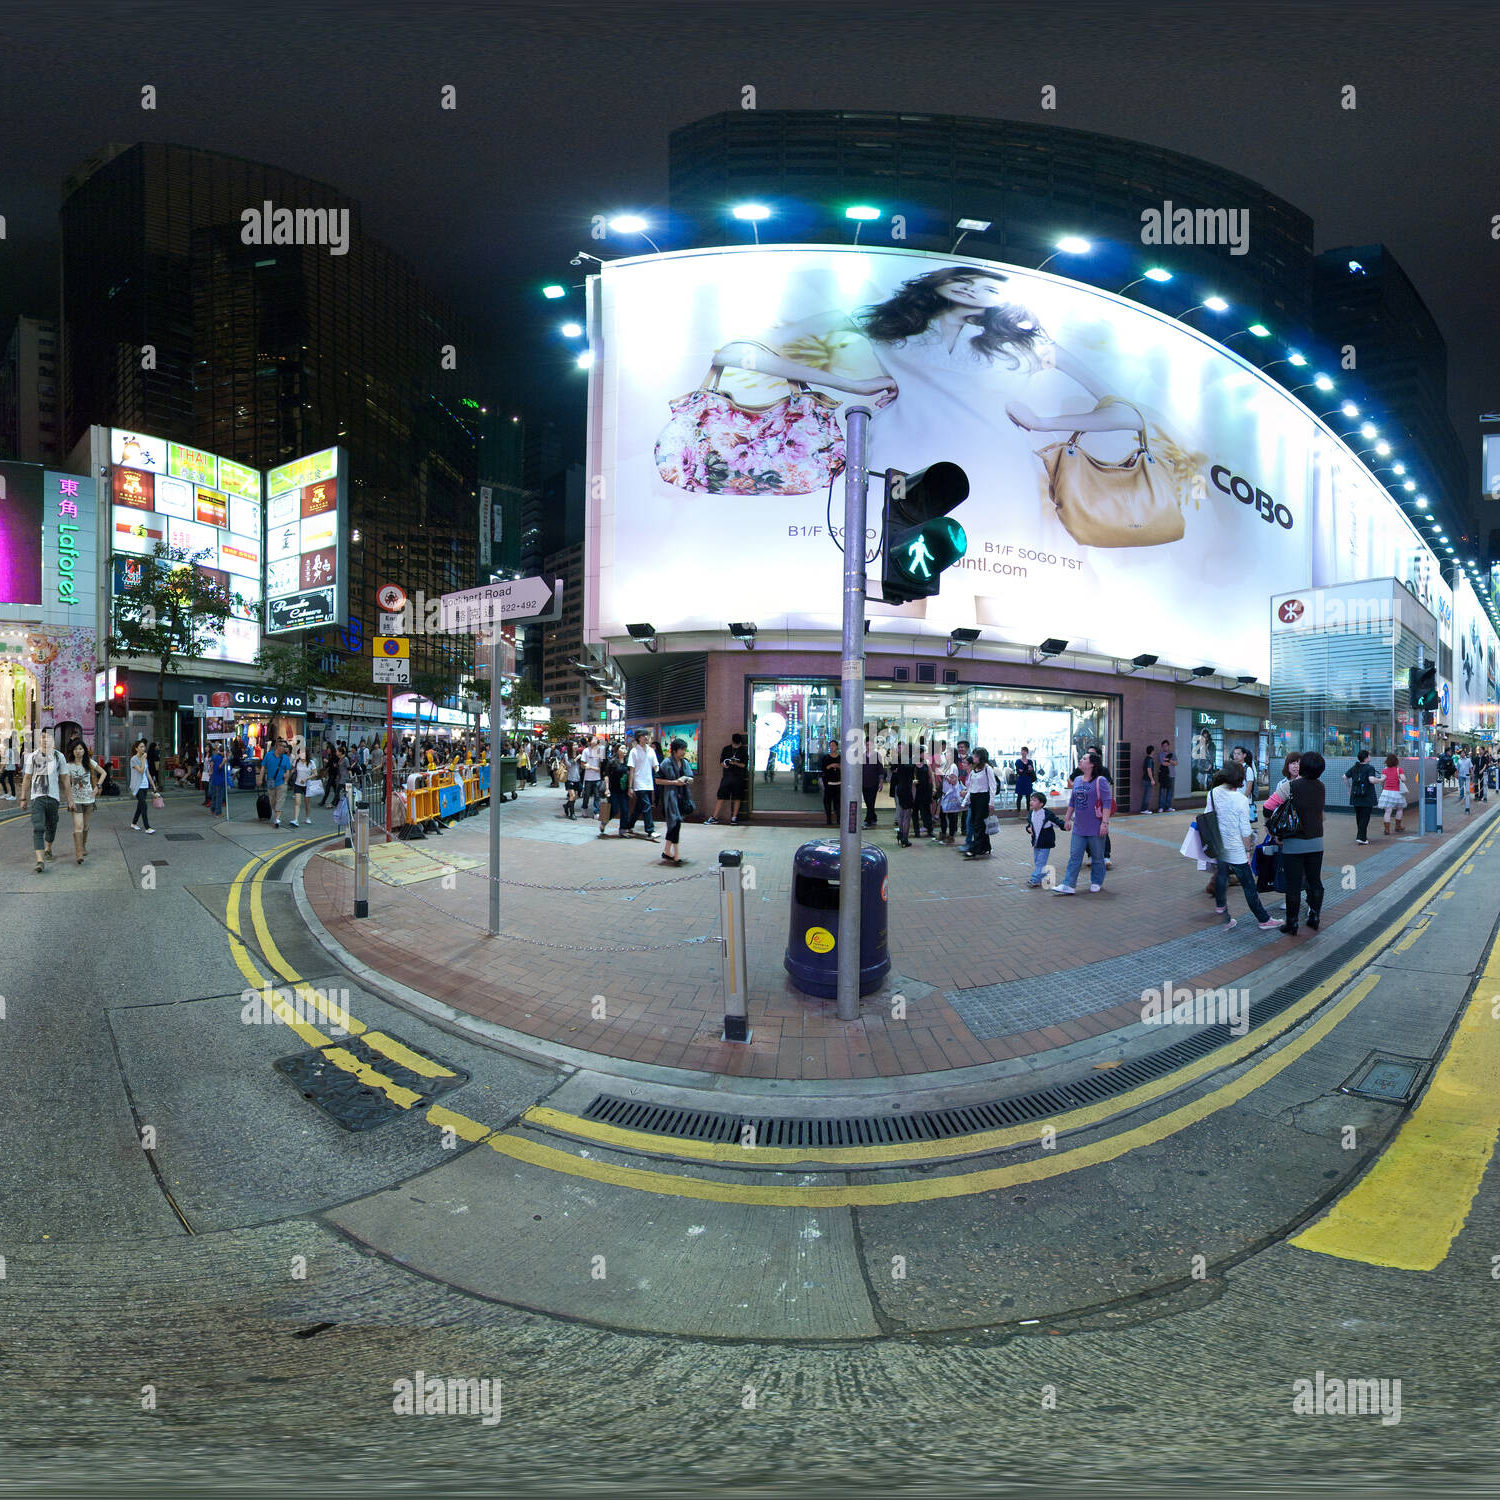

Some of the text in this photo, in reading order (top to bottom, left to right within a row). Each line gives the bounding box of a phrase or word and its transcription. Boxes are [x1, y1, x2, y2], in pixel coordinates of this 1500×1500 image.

[177, 446, 208, 465] THAI
[58, 479, 80, 519] 東角
[1210, 464, 1294, 531] COBO
[788, 525, 822, 537] B1/F
[984, 542, 1084, 570] B1/F SOGO TST
[58, 524, 80, 606] Laforet
[485, 586, 512, 599] Road
[396, 659, 402, 669] 7
[397, 673, 408, 682] 12
[1200, 713, 1217, 725] Dior
